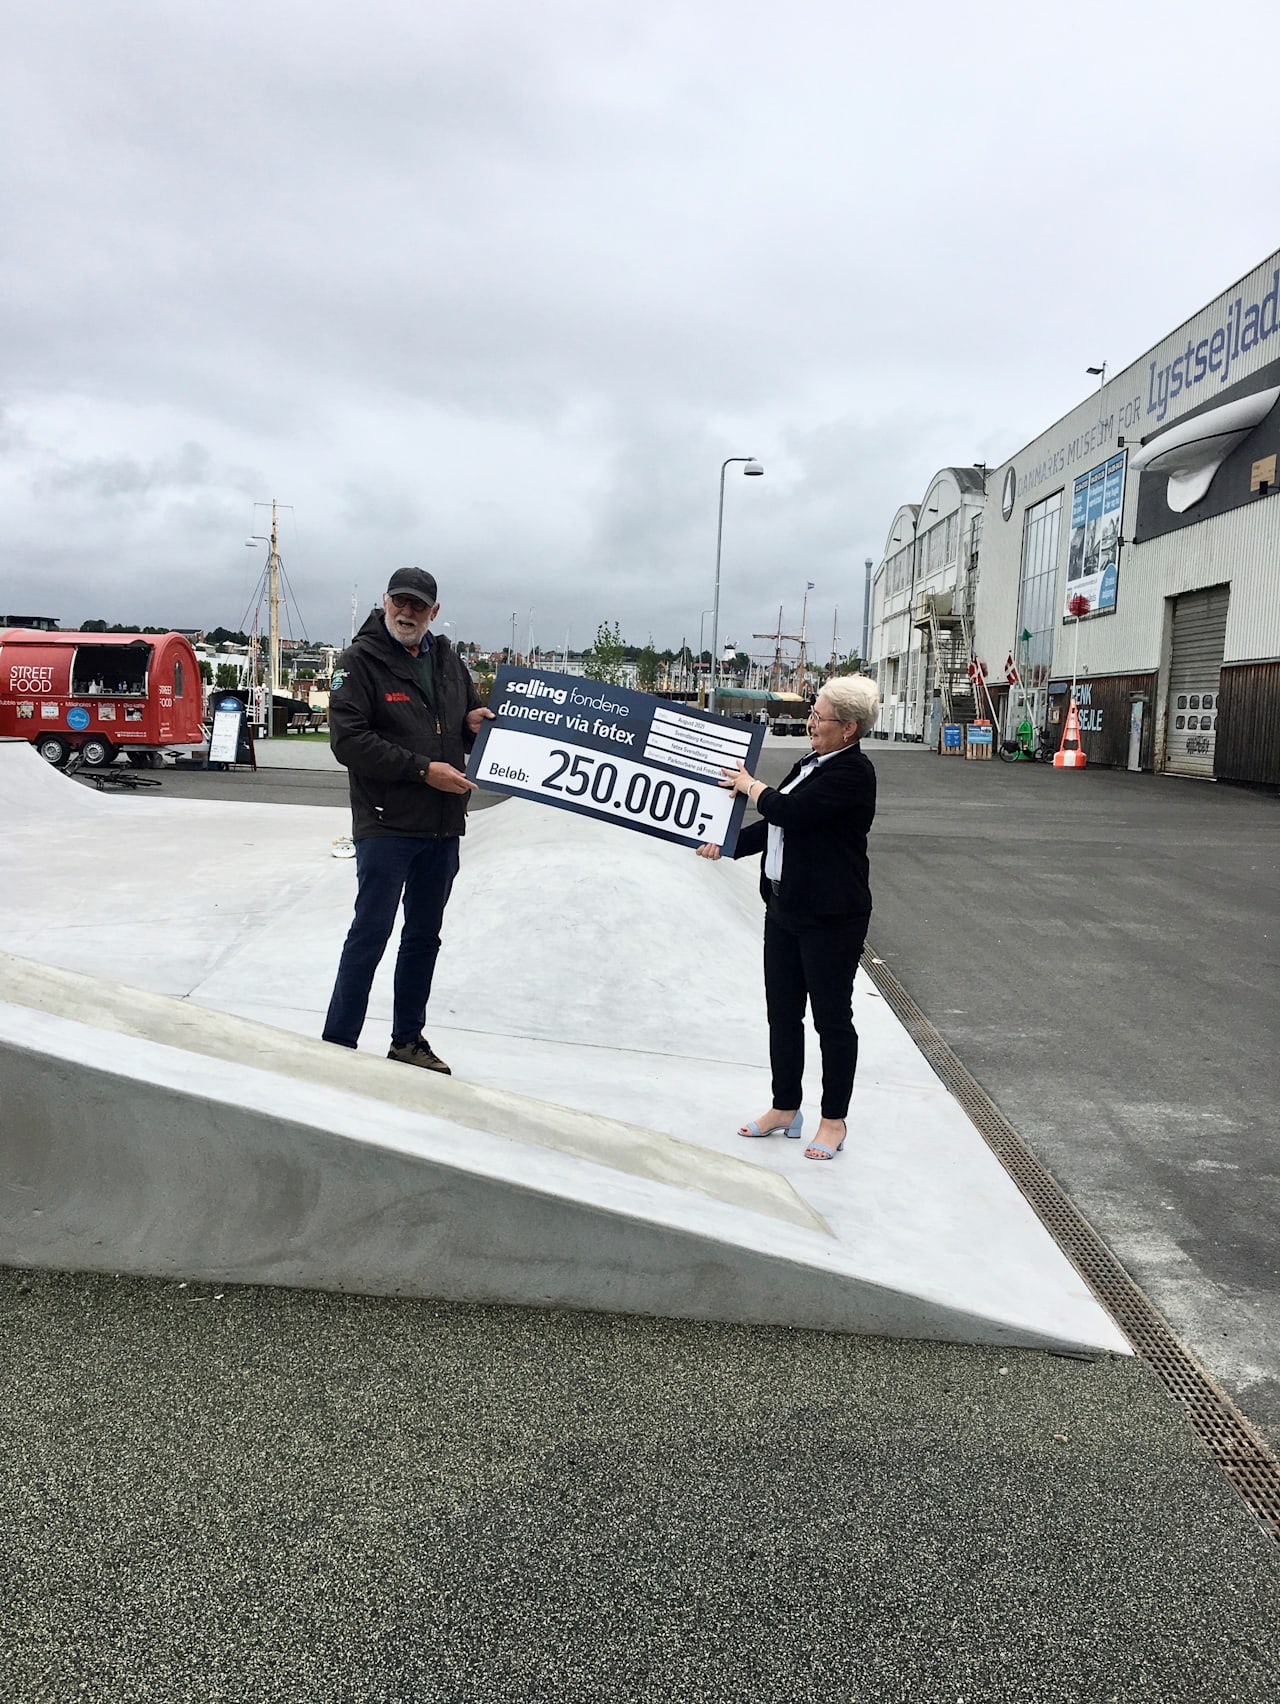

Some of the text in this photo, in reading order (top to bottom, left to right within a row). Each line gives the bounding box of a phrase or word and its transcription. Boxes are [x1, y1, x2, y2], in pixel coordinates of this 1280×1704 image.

[1067, 414, 1114, 466] MUSEUM
[1117, 396, 1141, 434] FOR
[10, 665, 54, 680] STREET
[9, 679, 52, 692] FOOD
[505, 679, 630, 717] salling fondene
[498, 700, 635, 746] donerer via føtex
[1079, 709, 1104, 731] SEJLE
[674, 729, 701, 743] Svendborg
[700, 736, 723, 748] Kommune
[683, 746, 708, 759] Svendborg
[489, 749, 714, 836] Beløb: 250.000,-
